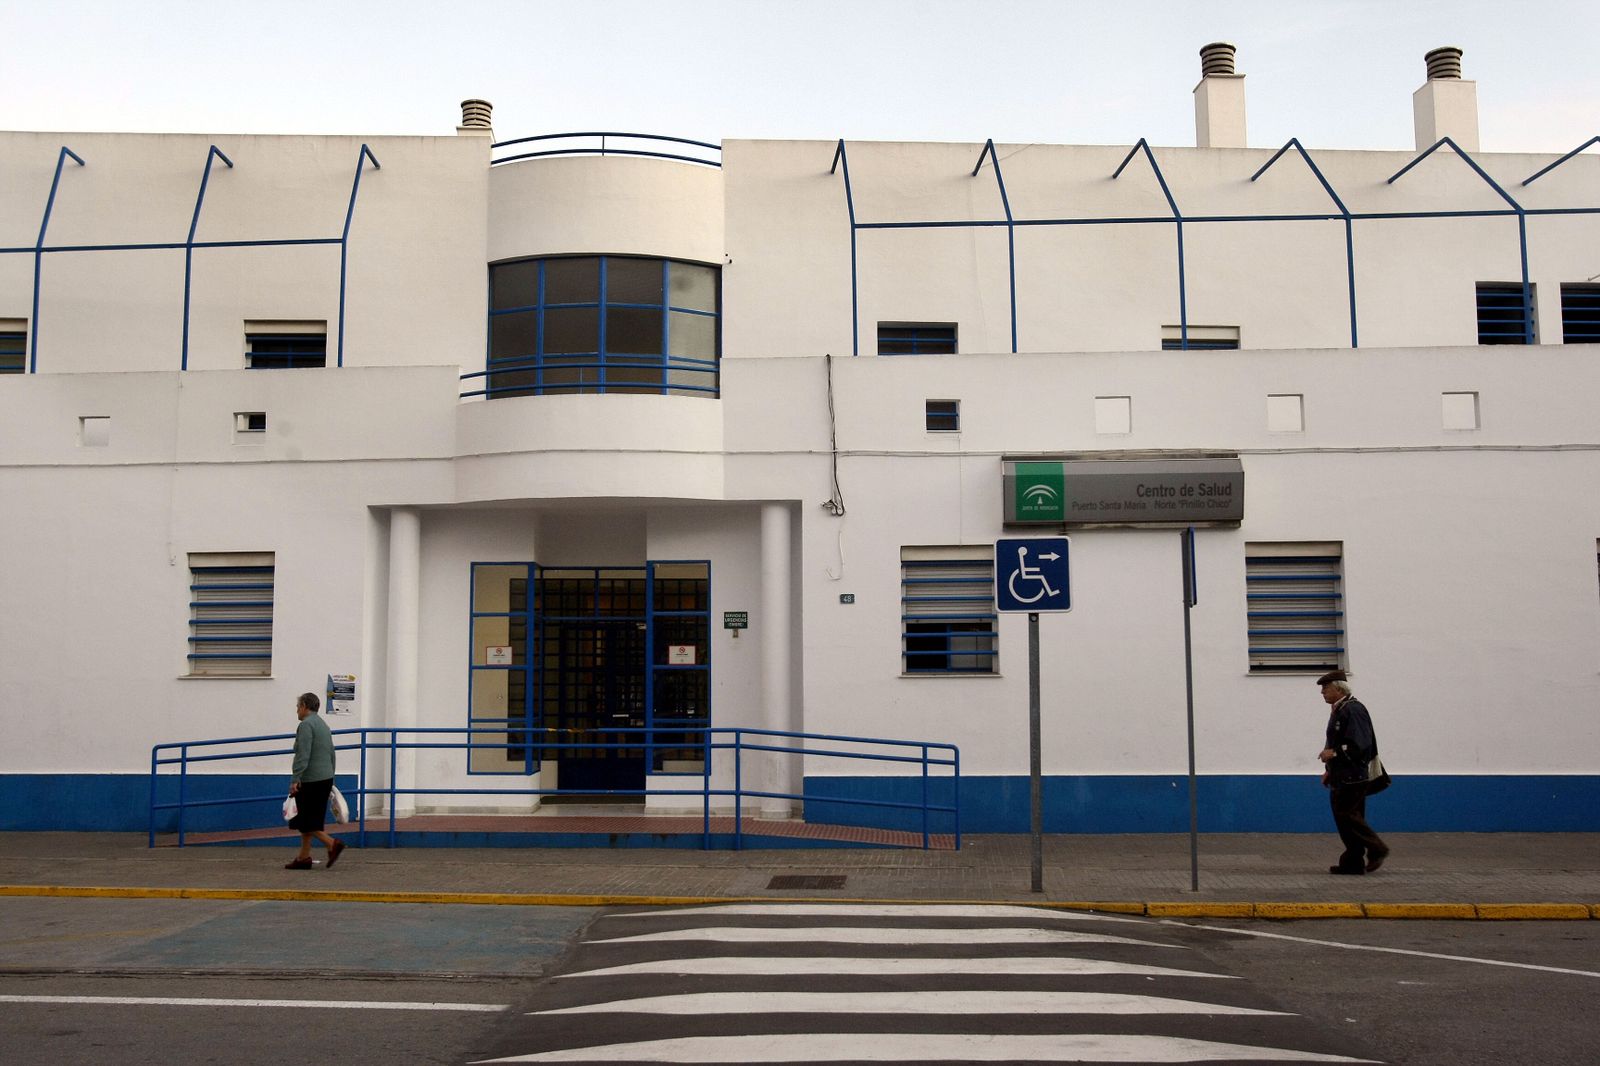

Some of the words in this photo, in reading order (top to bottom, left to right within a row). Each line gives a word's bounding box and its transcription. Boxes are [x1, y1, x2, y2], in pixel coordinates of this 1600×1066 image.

[1136, 483, 1176, 497] Centro
[1179, 483, 1194, 497] de
[1198, 482, 1232, 497] Salud
[1072, 500, 1097, 510] Puerto
[1099, 500, 1122, 510] Santa
[1154, 499, 1176, 509] Norte
